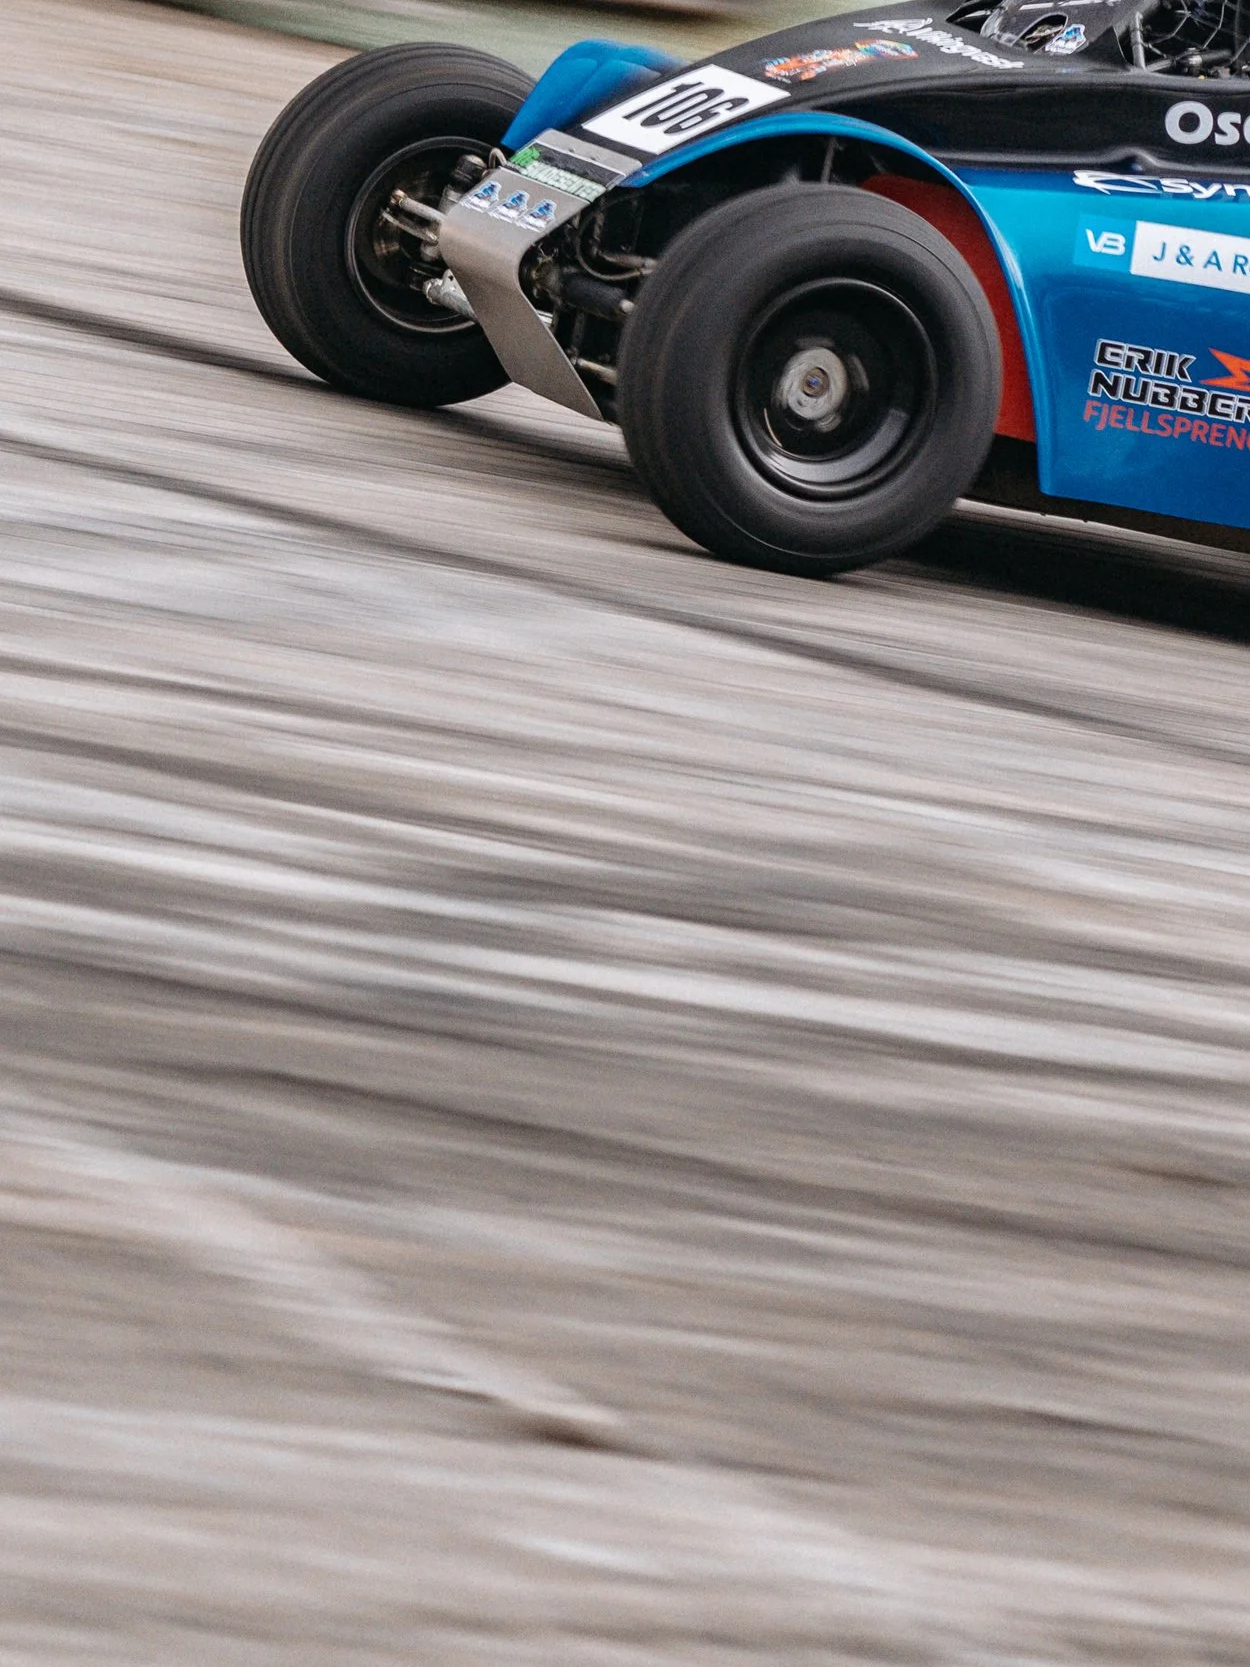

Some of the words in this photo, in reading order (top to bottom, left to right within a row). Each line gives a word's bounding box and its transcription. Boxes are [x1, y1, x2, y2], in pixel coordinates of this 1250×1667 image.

[622, 82, 750, 134] 106
[1085, 228, 1126, 255] VB
[1152, 242, 1167, 262] J
[1175, 247, 1194, 267] &
[1204, 250, 1223, 272] A
[1093, 338, 1197, 383] ERIK
